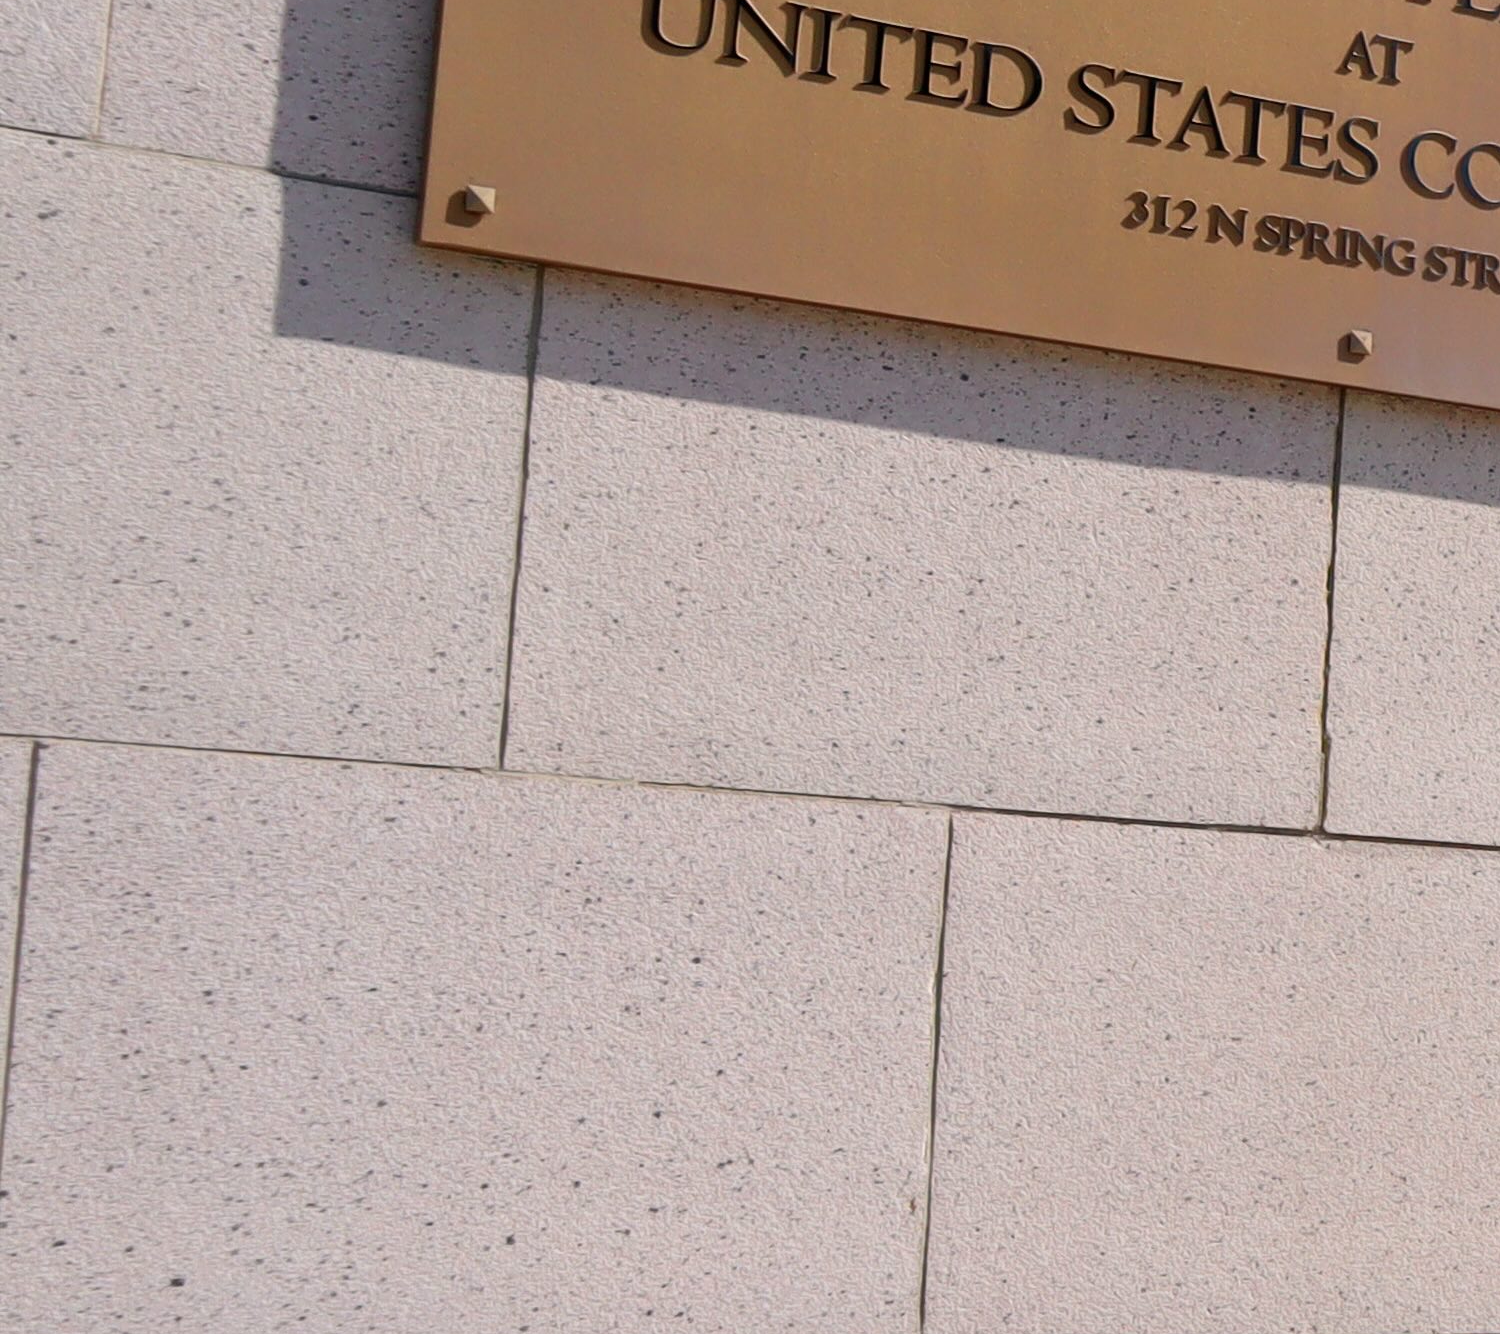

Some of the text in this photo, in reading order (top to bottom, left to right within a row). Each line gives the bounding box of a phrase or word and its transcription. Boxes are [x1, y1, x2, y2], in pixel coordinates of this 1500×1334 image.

[1335, 29, 1412, 86] AT
[1063, 62, 1380, 182] STATES
[1121, 190, 1201, 239] 312
[1206, 206, 1249, 246] N
[1251, 210, 1417, 280] SPRING
